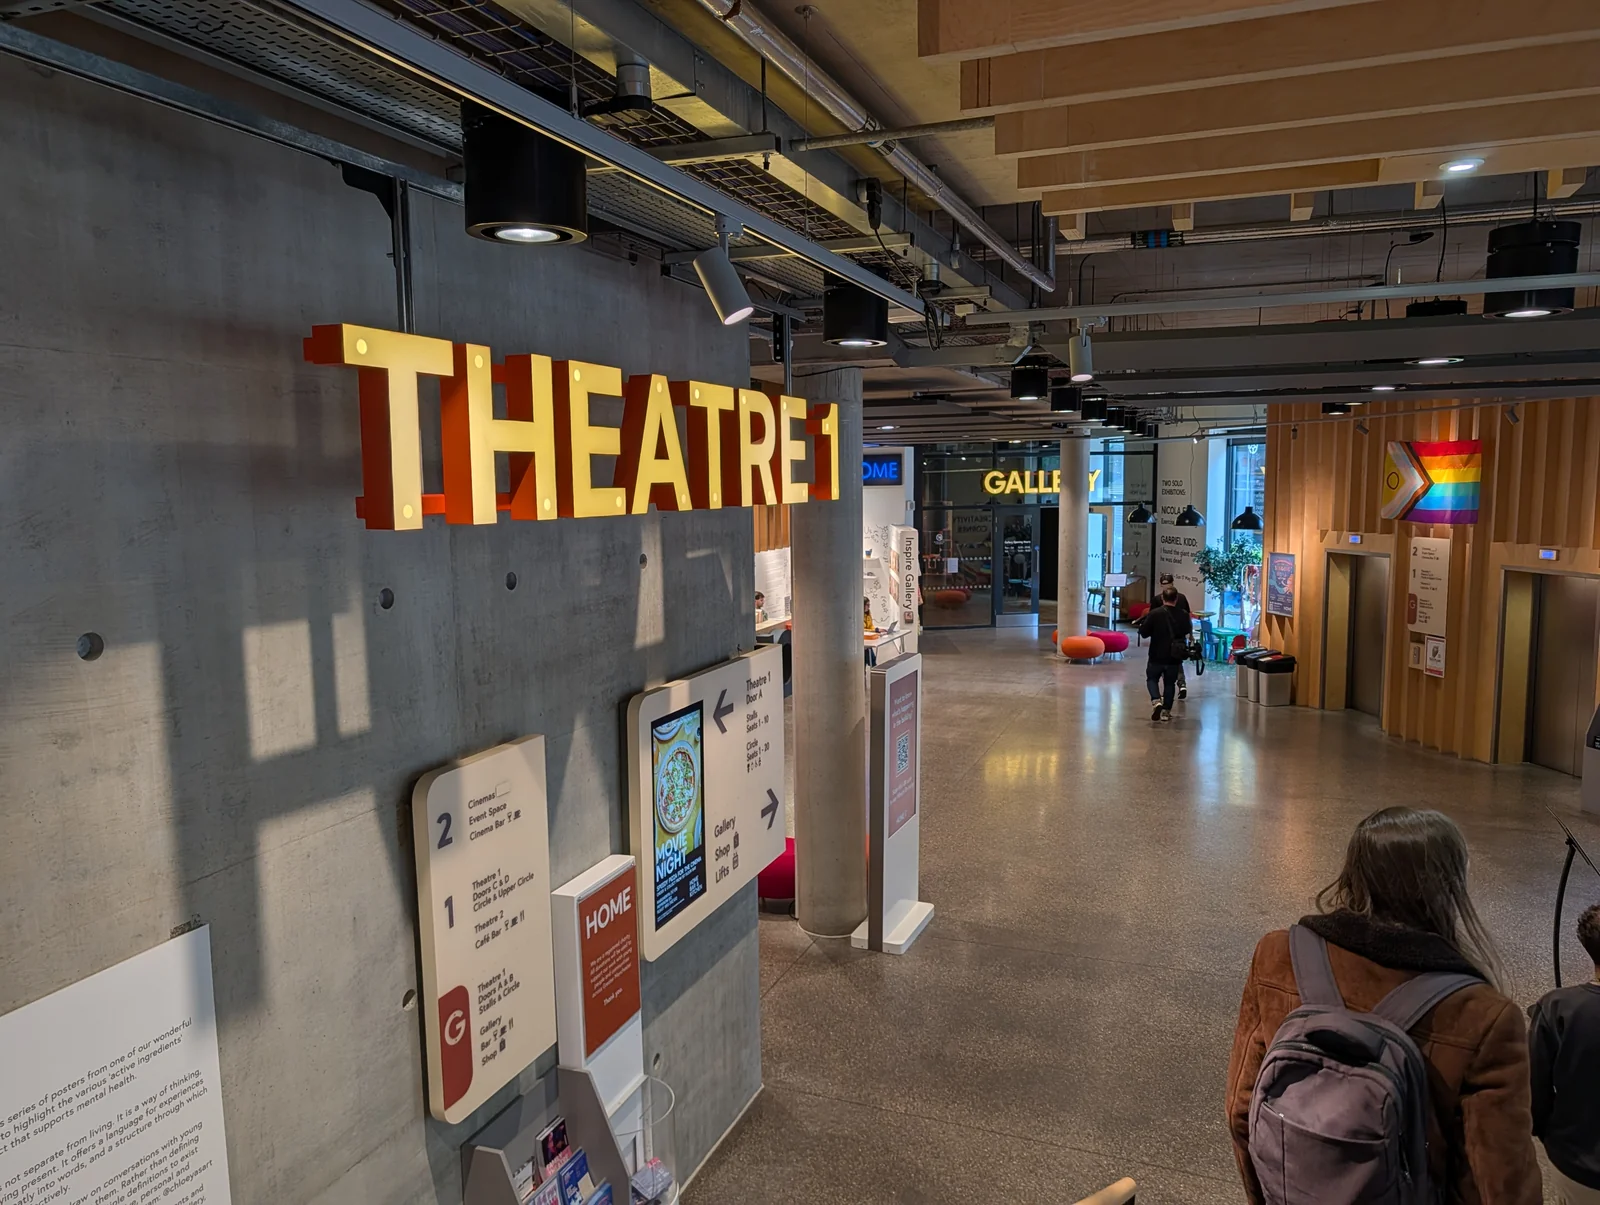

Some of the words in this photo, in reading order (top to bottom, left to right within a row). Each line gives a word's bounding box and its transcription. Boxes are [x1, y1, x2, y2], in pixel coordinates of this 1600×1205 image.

[340, 323, 809, 531] THEATRE
[821, 403, 840, 500] 1
[862, 461, 898, 479] OME
[983, 469, 1101, 494] GALLEY
[1161, 505, 1181, 515] NICOLA
[1160, 535, 1182, 546] GABRIEL
[1183, 537, 1198, 548] KIDD:
[1162, 547, 1173, 555] found
[1412, 547, 1418, 556] 2
[903, 537, 914, 571] Inspire
[1412, 569, 1416, 578] 1
[903, 574, 915, 610] Gallery
[1409, 601, 1416, 609] G
[746, 676, 767, 692] Theatre
[746, 693, 758, 705] Door
[759, 689, 763, 699] A
[746, 710, 758, 723] Stalls
[746, 722, 758, 733] Seats
[746, 738, 758, 751] Circle
[746, 750, 758, 762] Seats
[468, 792, 496, 809] Cinemas
[469, 811, 488, 826] Event
[488, 802, 507, 818] Space
[436, 812, 453, 850] 2
[469, 824, 494, 841] Cinema
[494, 818, 506, 830] Bar
[714, 816, 736, 838] Gallery
[656, 828, 687, 865] MOVIE
[715, 844, 730, 862] Shop
[656, 847, 688, 882] NIGHT
[715, 865, 730, 884] Lifts
[472, 872, 497, 891] Theatre
[472, 886, 492, 902] Doors
[492, 881, 498, 890] C
[504, 874, 510, 884] D
[472, 896, 492, 912] Circle
[498, 882, 516, 898] Upper
[517, 872, 535, 887] Circle
[444, 895, 455, 930] 1
[585, 886, 632, 940] HOME
[474, 915, 498, 934] Theatre
[475, 933, 490, 950] Café
[491, 928, 502, 940] Bar
[477, 973, 501, 994] Theatre
[478, 987, 497, 1005] Doors
[509, 973, 514, 983] B
[479, 997, 497, 1015] Stalls
[502, 980, 520, 998] Circle
[444, 1009, 466, 1046] G
[479, 1015, 502, 1036] Gallery
[480, 1038, 492, 1052] Bar
[481, 1049, 498, 1067] Shop
[7, 1103, 36, 1124] series
[38, 1094, 49, 1106] of
[51, 1077, 85, 1102] posters
[87, 1065, 108, 1080] from
[109, 1055, 126, 1069] one
[127, 1046, 137, 1059] of
[138, 1041, 152, 1053] our
[153, 1017, 192, 1045] wonderful
[0, 1130, 11, 1141] to
[13, 1105, 56, 1134] highlight
[58, 1096, 73, 1109] the
[75, 1077, 107, 1099] various
[108, 1062, 136, 1080] 'active
[137, 1034, 183, 1066] ingredients'
[10, 1132, 31, 1149] that
[33, 1108, 75, 1136] supports
[76, 1088, 107, 1112] mental
[108, 1072, 137, 1094] health.
[4, 1174, 21, 1189] not
[23, 1149, 65, 1178] separate
[66, 1135, 88, 1152] from
[89, 1120, 115, 1139] living.
[116, 1113, 124, 1122] It
[125, 1109, 132, 1118] is
[134, 1104, 140, 1112] a
[141, 1094, 158, 1107] way
[159, 1085, 168, 1097] of
[169, 1069, 202, 1091] thinking,
[21, 1166, 60, 1195] present.
[61, 1158, 69, 1168] It
[70, 1143, 97, 1163] offers
[98, 1138, 104, 1146] a
[105, 1114, 144, 1142] language
[145, 1105, 158, 1117] for
[159, 1078, 204, 1109] experiences
[37, 1180, 56, 1196] into
[57, 1163, 88, 1183] words,
[89, 1147, 106, 1164] and
[107, 1145, 113, 1153] a
[115, 1121, 153, 1148] structure
[154, 1099, 185, 1124] through
[185, 1086, 208, 1104] which
[90, 1186, 102, 1197] on
[103, 1148, 160, 1189] conversations
[161, 1135, 178, 1152] with
[179, 1121, 203, 1143] young
[94, 1187, 120, 1205] them.
[121, 1167, 148, 1190] Rather
[149, 1156, 168, 1171] than
[169, 1135, 200, 1159] defining
[126, 1167, 168, 1198] definitions
[170, 1160, 179, 1169] to
[180, 1146, 199, 1163] exist
[140, 1172, 174, 1203] personal
[175, 1161, 190, 1178] and
[162, 1160, 213, 1197] @chloeyasart
[190, 1183, 205, 1199] and
